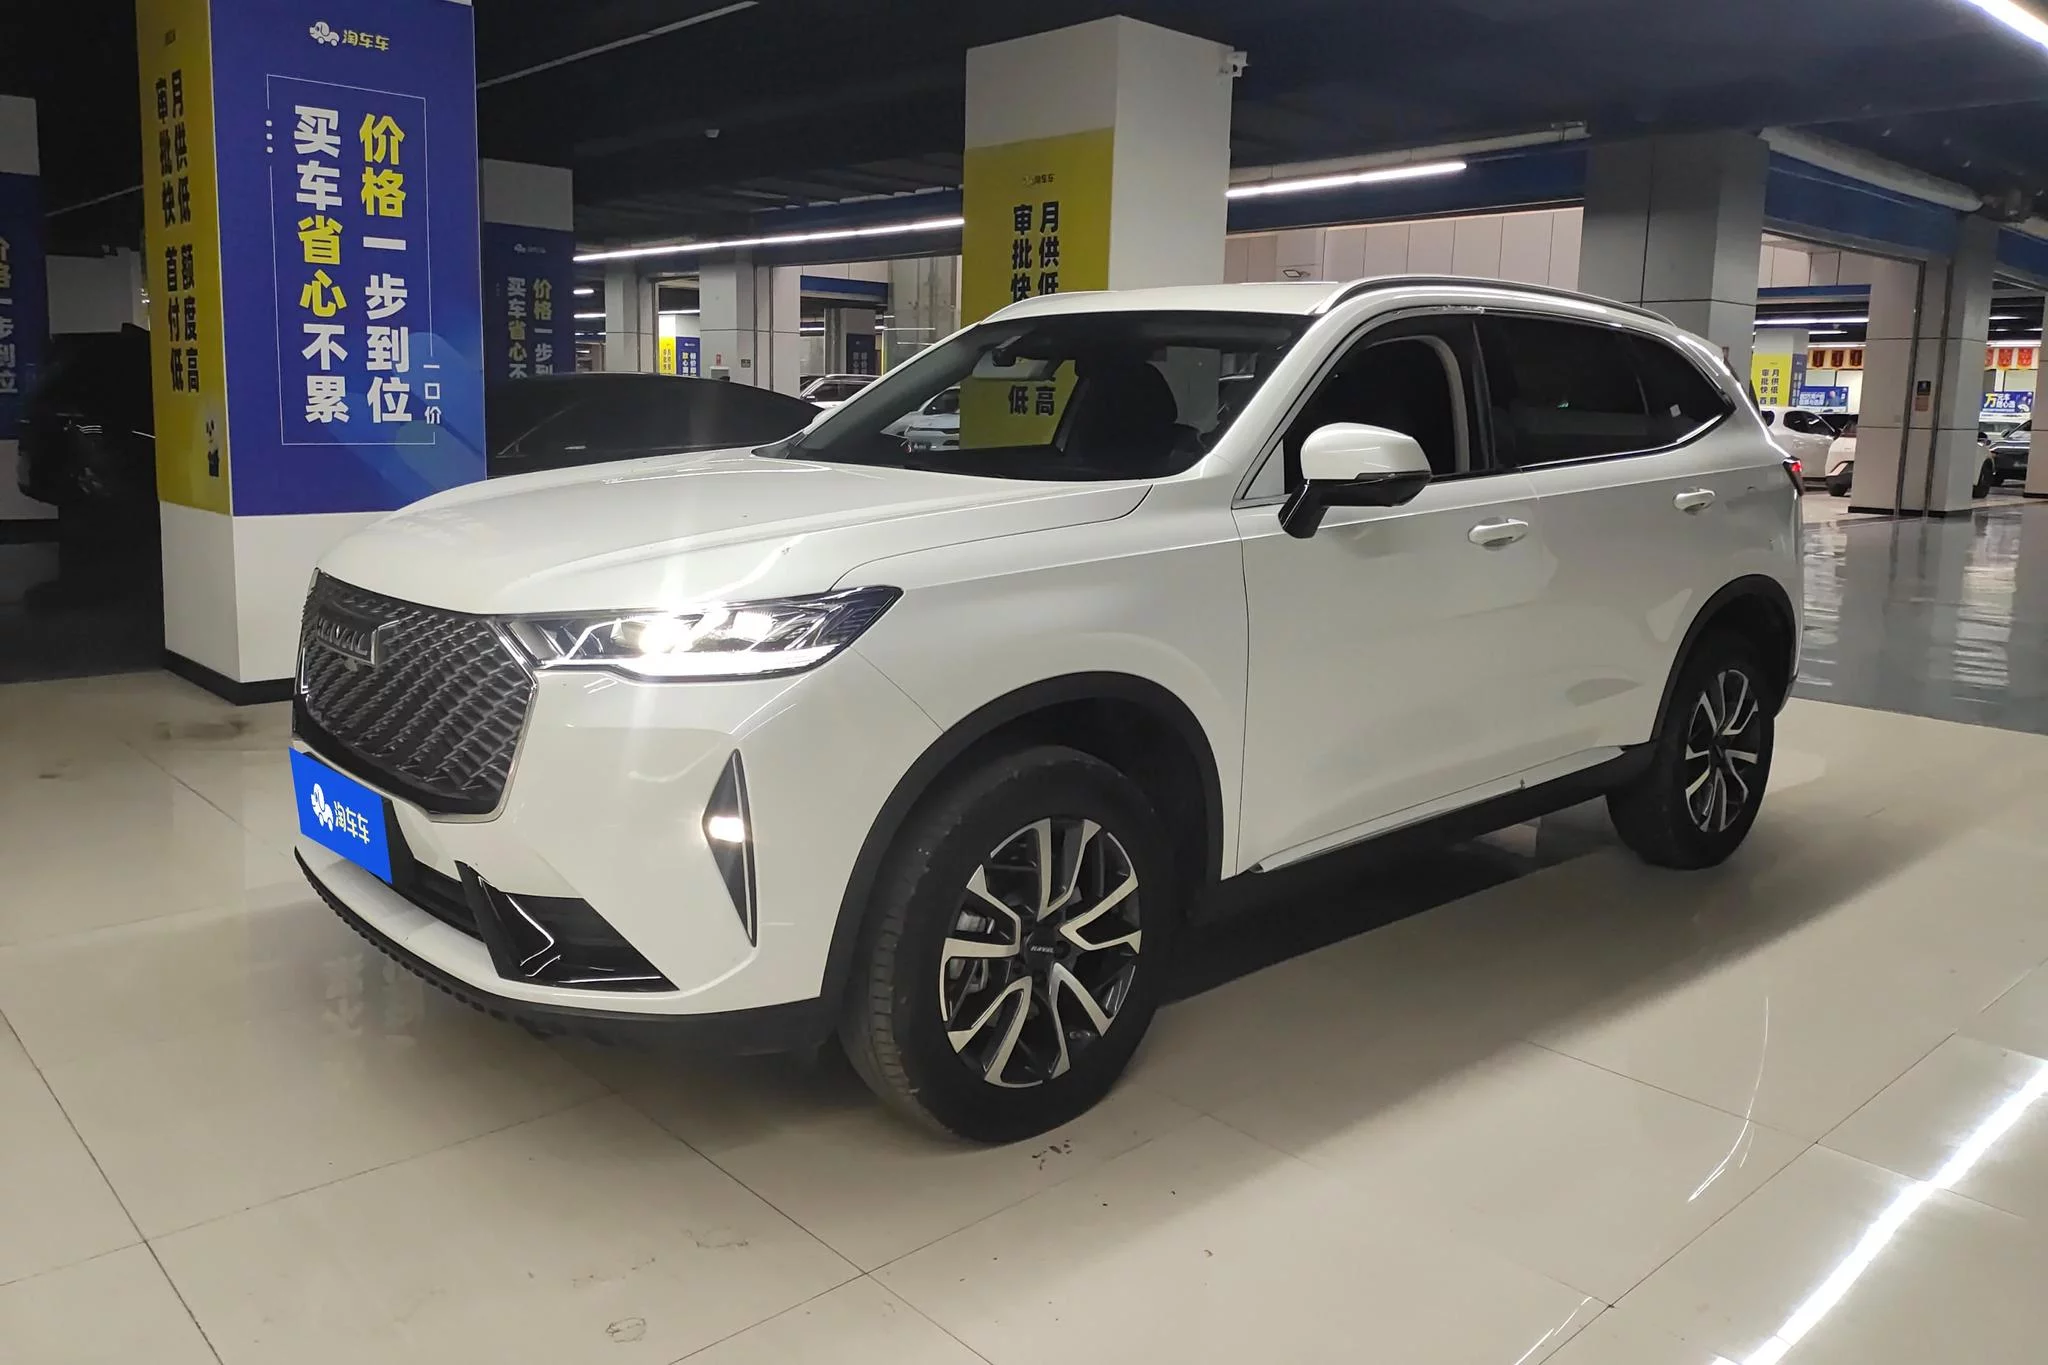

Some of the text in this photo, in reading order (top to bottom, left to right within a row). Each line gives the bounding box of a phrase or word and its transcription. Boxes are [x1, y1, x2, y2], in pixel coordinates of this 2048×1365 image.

[341, 29, 390, 51] 淘车车
[294, 105, 350, 424] 买车省心不累
[359, 113, 412, 424] 价格一步到位
[423, 364, 442, 425] 一口价
[333, 800, 371, 845] 淘车车
